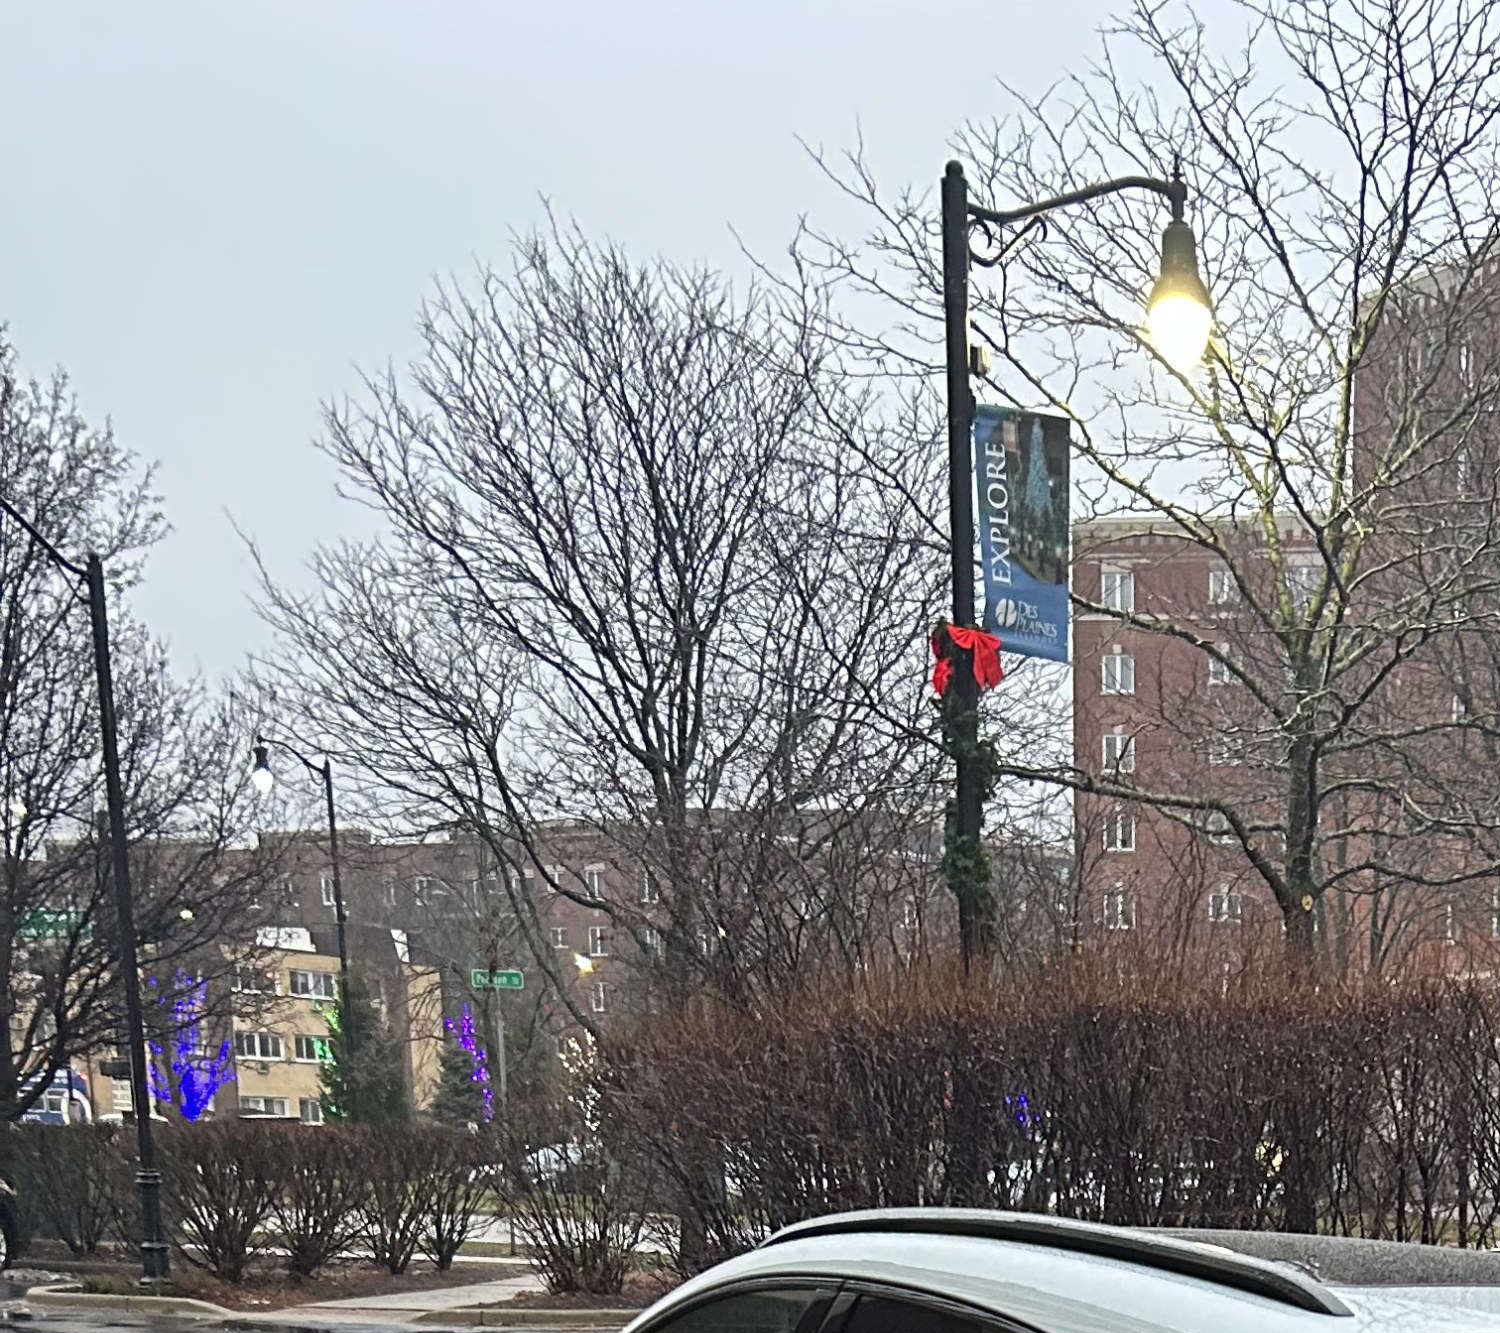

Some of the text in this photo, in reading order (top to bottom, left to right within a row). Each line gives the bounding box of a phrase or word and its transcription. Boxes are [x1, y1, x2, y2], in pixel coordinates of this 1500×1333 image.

[985, 442, 1011, 586] EXPLORE
[1018, 600, 1038, 619] DES
[1016, 616, 1057, 637] PLAINES
